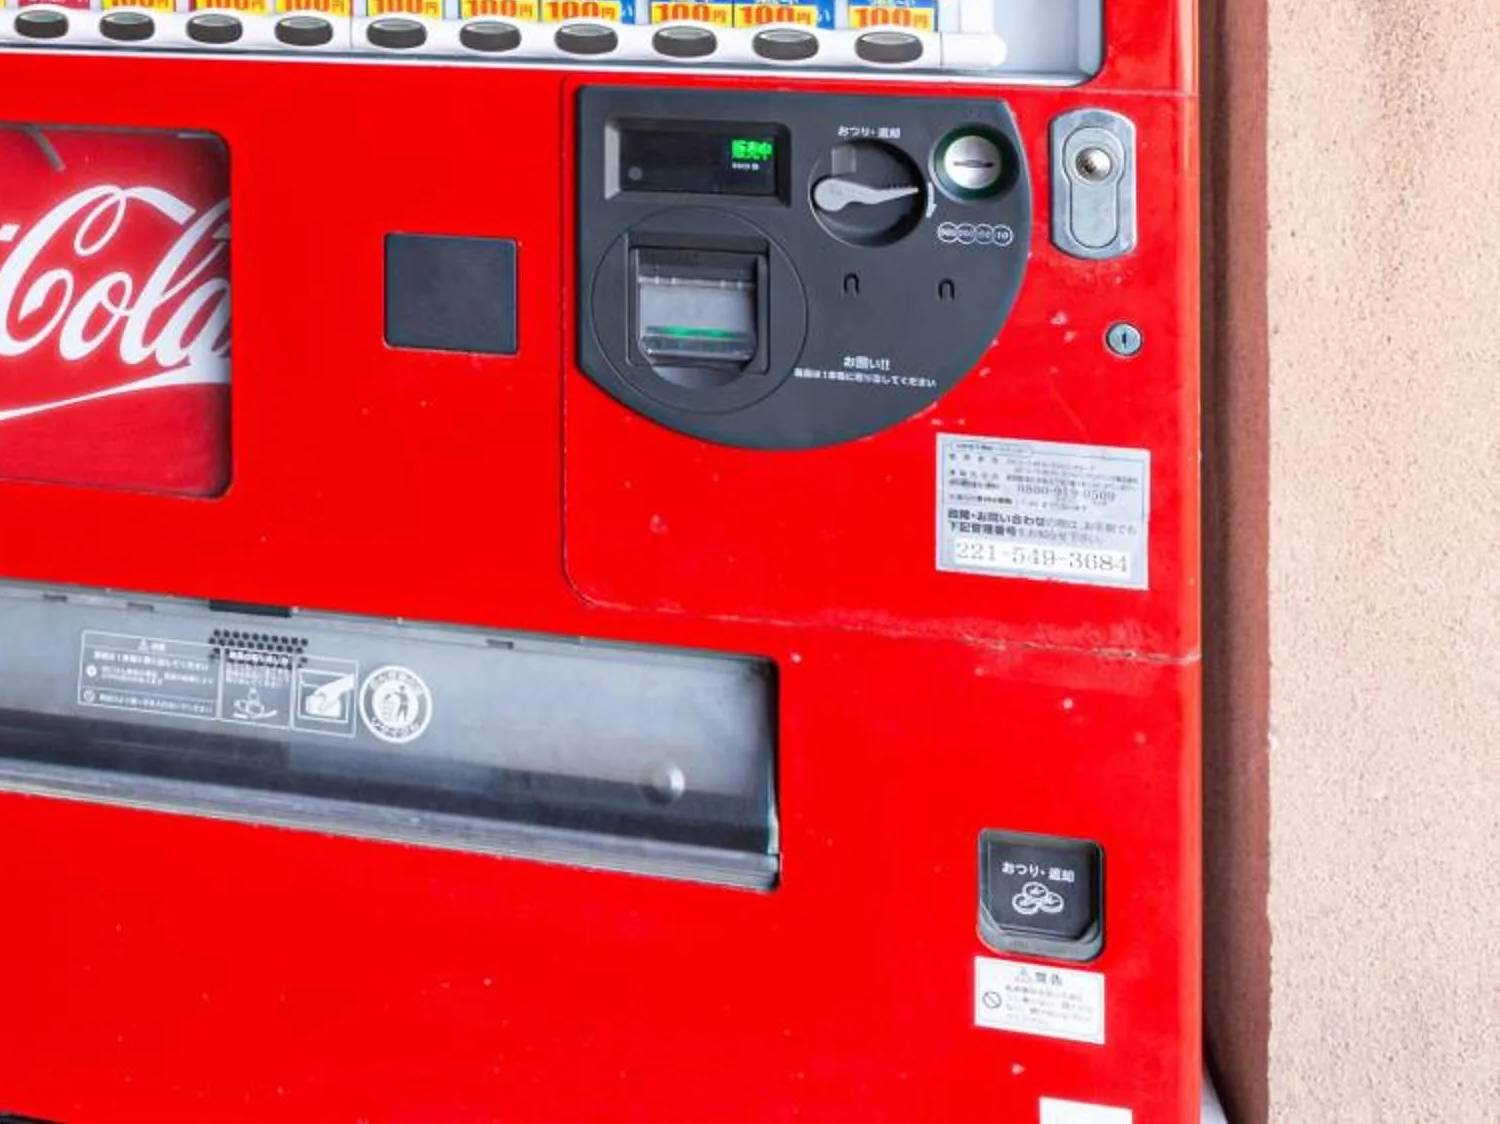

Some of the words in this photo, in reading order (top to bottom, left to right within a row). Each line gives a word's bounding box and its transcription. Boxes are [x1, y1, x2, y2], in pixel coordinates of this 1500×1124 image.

[465, 0, 533, 17] 100円
[545, 1, 616, 20] 100円
[655, 3, 726, 22] 100円
[739, 6, 812, 25] 100円
[854, 7, 930, 28] 100円
[955, 541, 1129, 574] 221-549-3684
